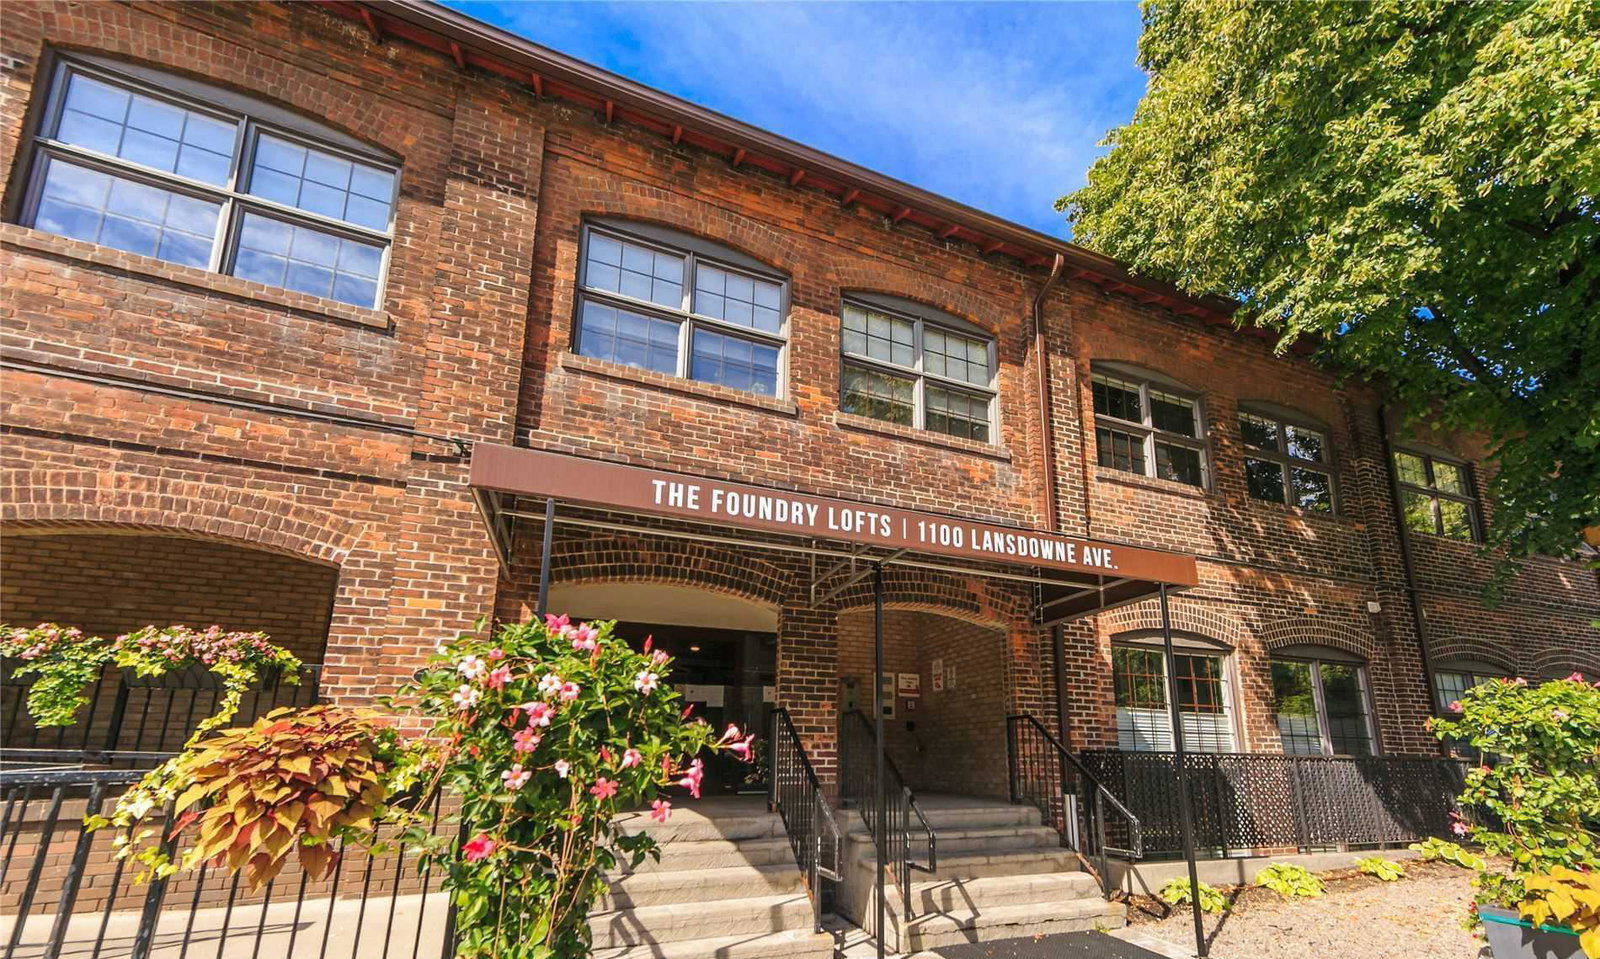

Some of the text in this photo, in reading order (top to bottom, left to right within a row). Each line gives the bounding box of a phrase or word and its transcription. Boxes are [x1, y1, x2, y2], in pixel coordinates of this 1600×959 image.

[652, 479, 1118, 570] THE FOUNDRY LOFTS 1100 LANSDOWNE AVE.
